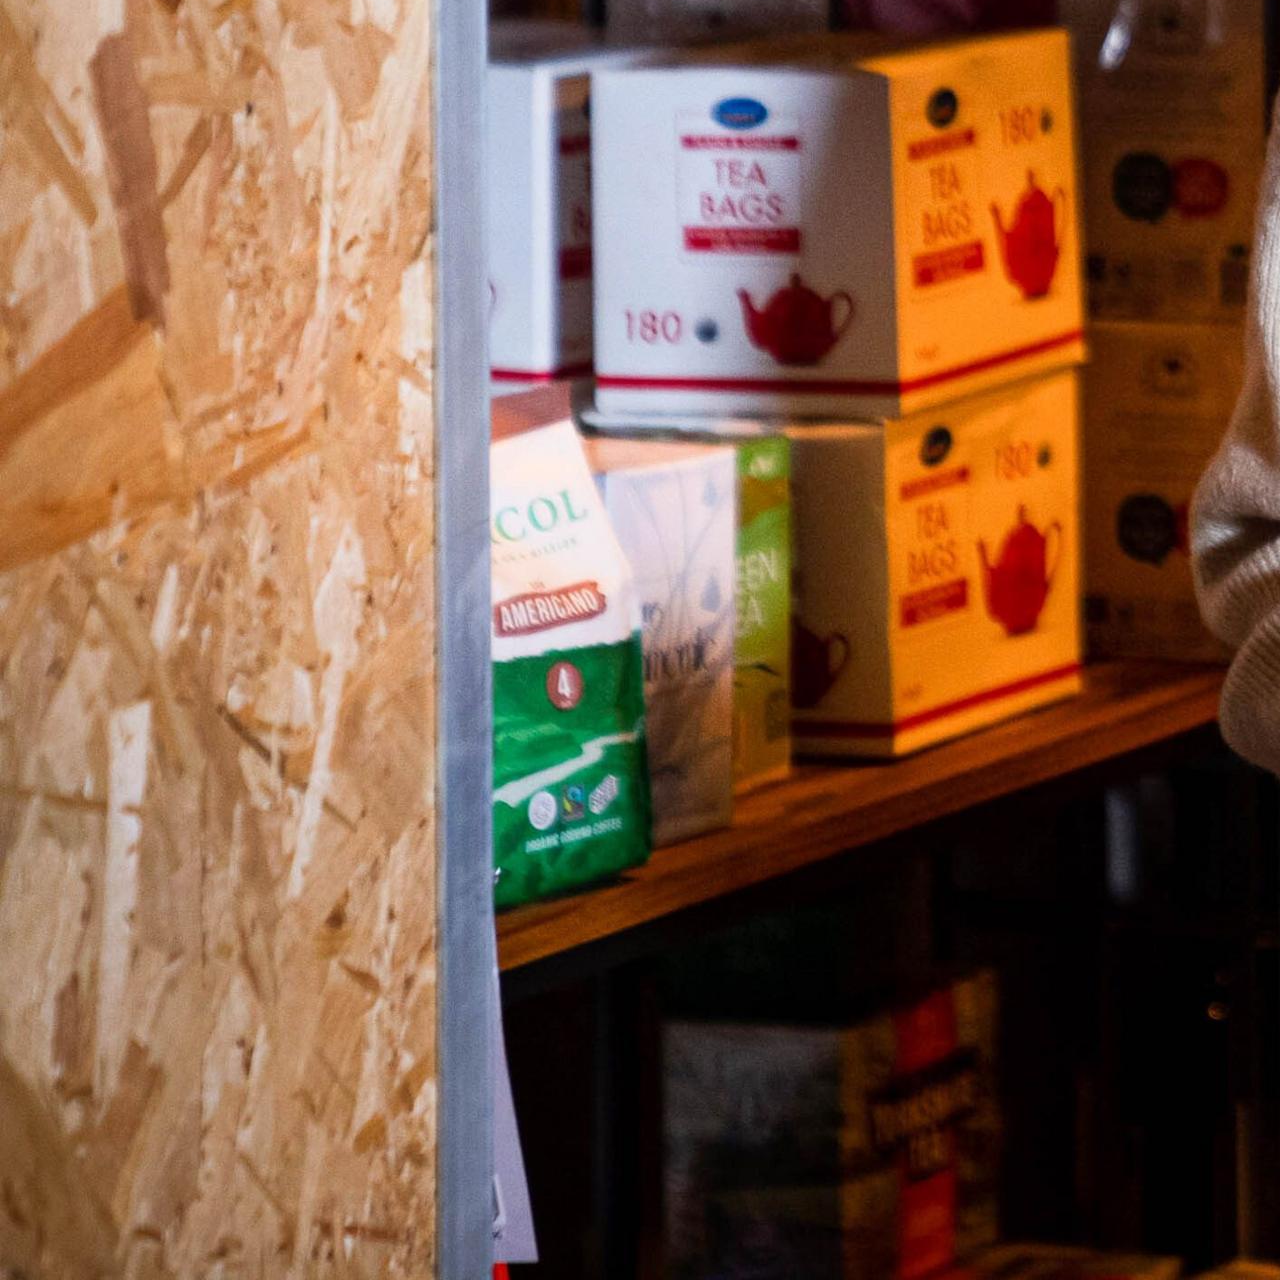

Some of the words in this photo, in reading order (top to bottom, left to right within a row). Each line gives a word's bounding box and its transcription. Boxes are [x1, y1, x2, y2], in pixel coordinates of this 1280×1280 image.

[715, 157, 768, 189] TEA
[700, 192, 785, 224] BAGS
[625, 308, 684, 345] 180
[500, 587, 600, 632] AMERICANO
[557, 667, 573, 699] 4
